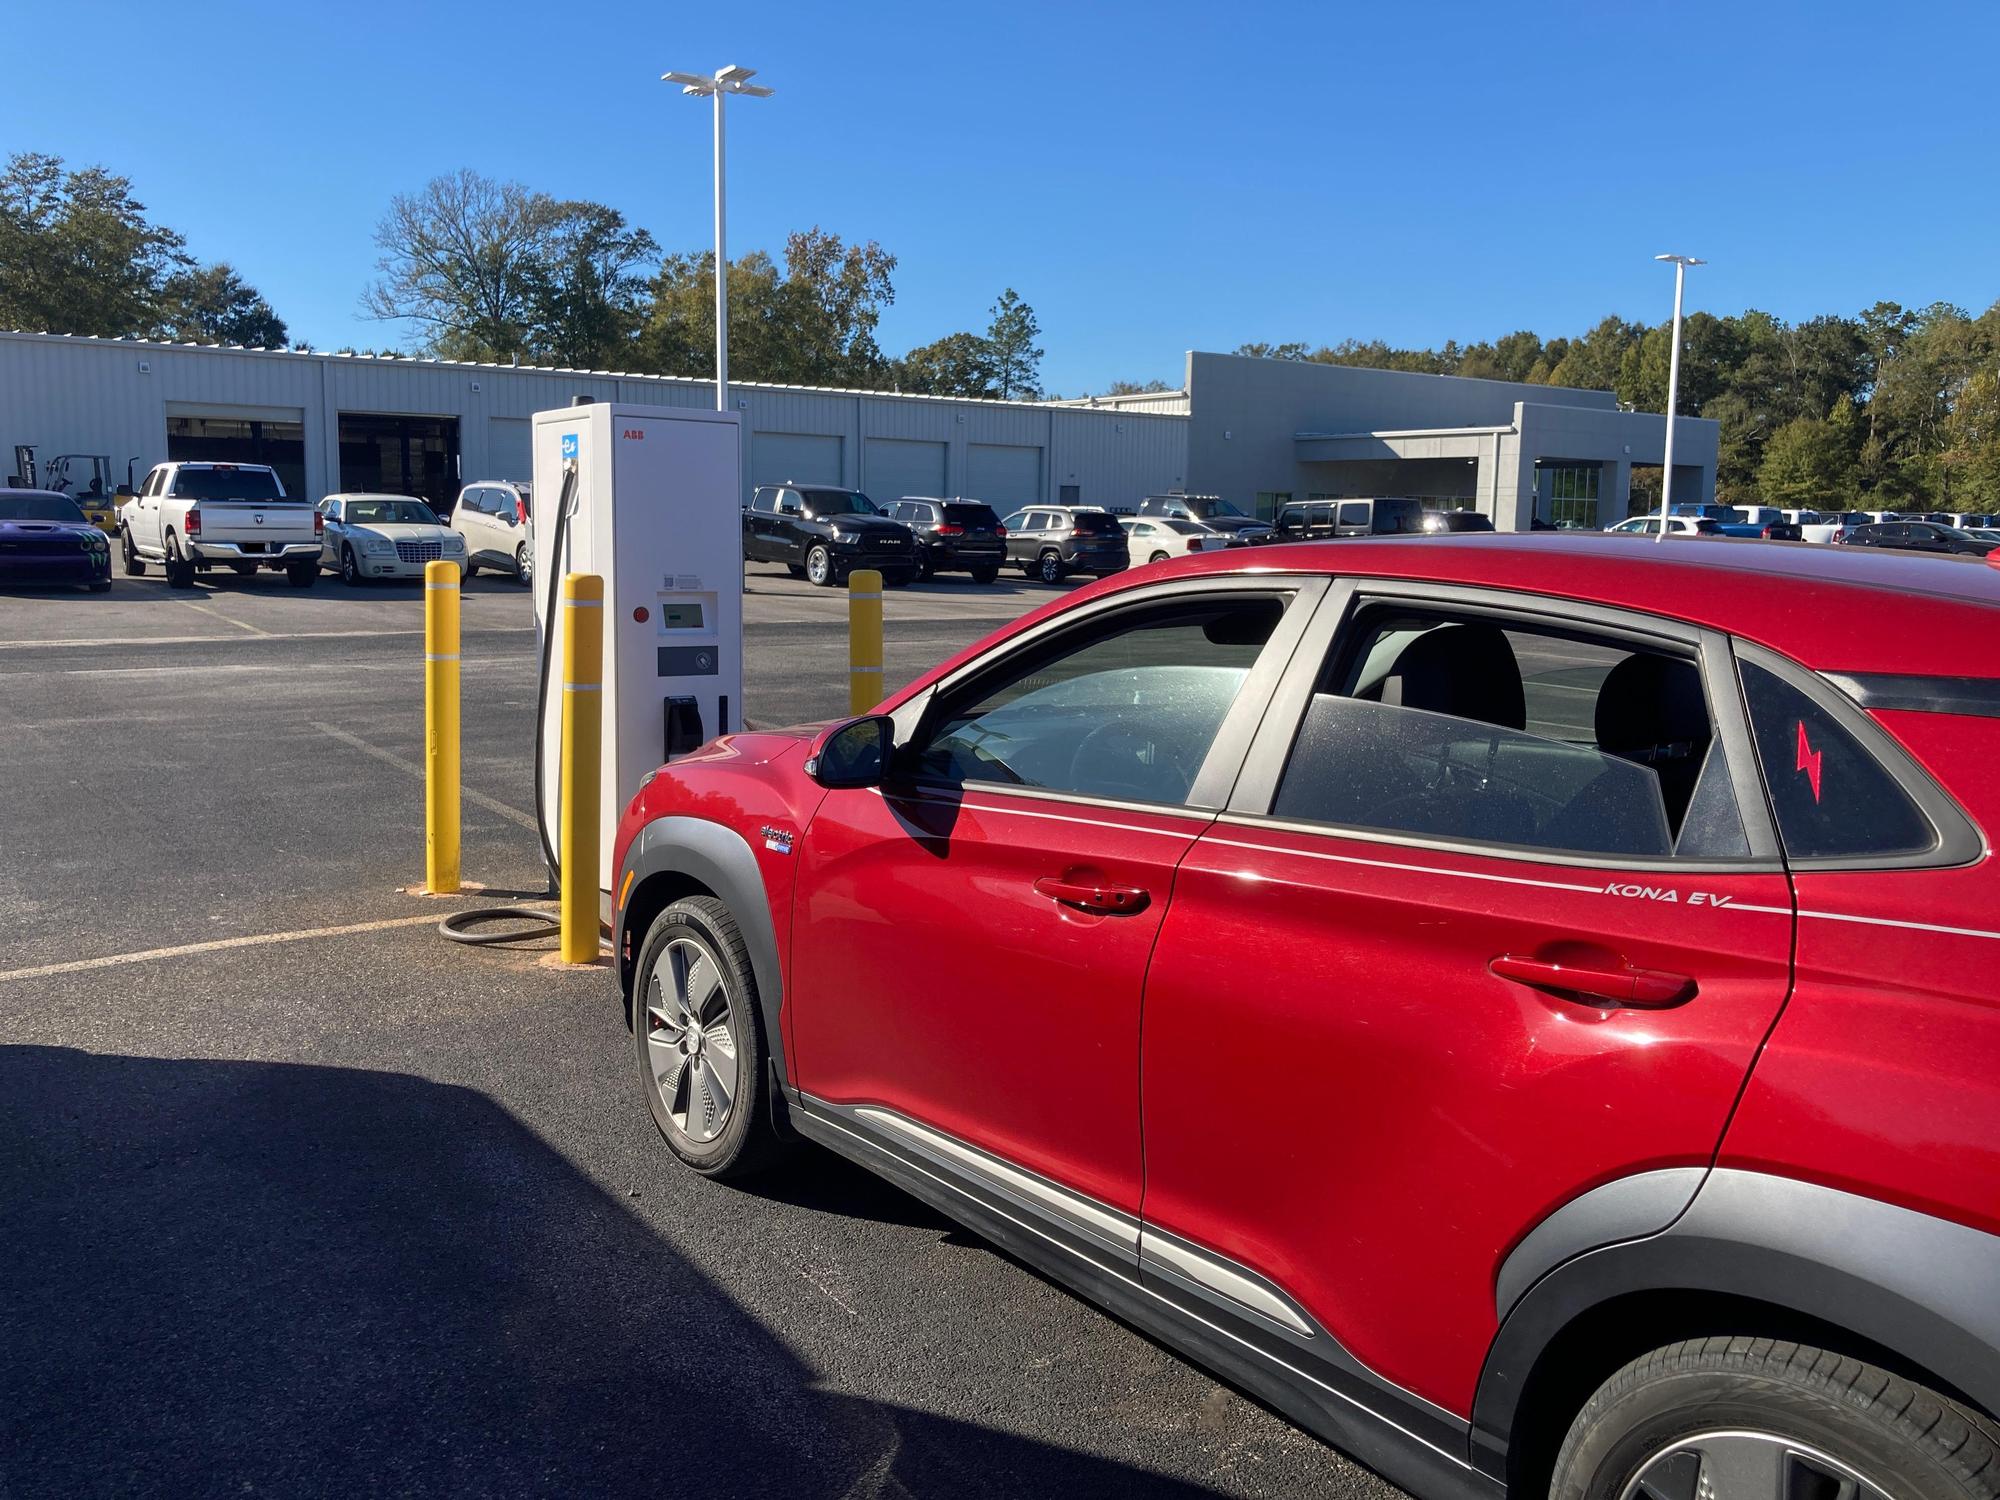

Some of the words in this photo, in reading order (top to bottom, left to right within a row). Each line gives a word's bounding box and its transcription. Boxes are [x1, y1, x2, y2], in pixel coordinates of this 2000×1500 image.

[623, 430, 644, 440] ABB
[1604, 882, 1678, 903] KONA
[1686, 891, 1733, 907] EV
